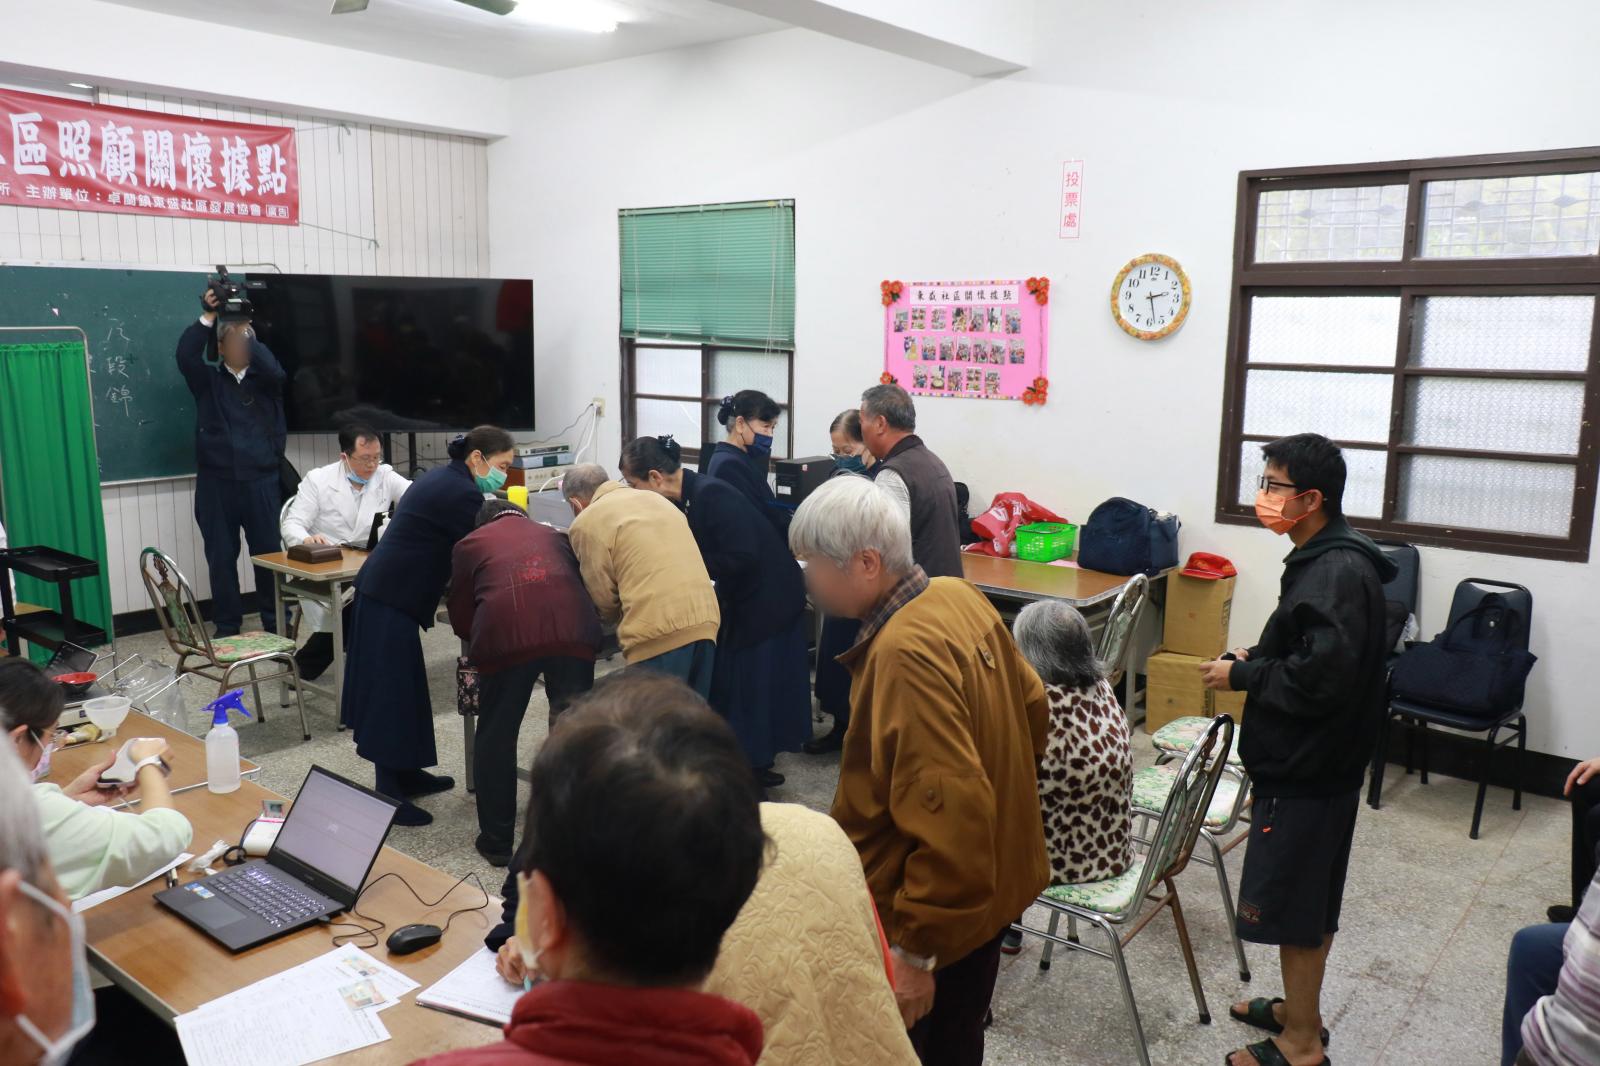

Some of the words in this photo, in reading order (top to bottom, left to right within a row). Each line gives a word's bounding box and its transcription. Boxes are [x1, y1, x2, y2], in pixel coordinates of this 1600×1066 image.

[0, 112, 288, 197] 區照顧關懷據點
[1064, 171, 1079, 227] 投票處
[1138, 269, 1147, 279] 11
[1150, 266, 1161, 277] 12
[1164, 270, 1169, 281] 1
[1128, 278, 1140, 288] 10
[1171, 280, 1178, 290] 2
[1125, 290, 1132, 301] 9
[1172, 293, 1180, 303] 3
[1128, 303, 1135, 313] 8
[1135, 313, 1142, 323] 7
[1146, 317, 1153, 328] 6
[1158, 315, 1165, 325] 5
